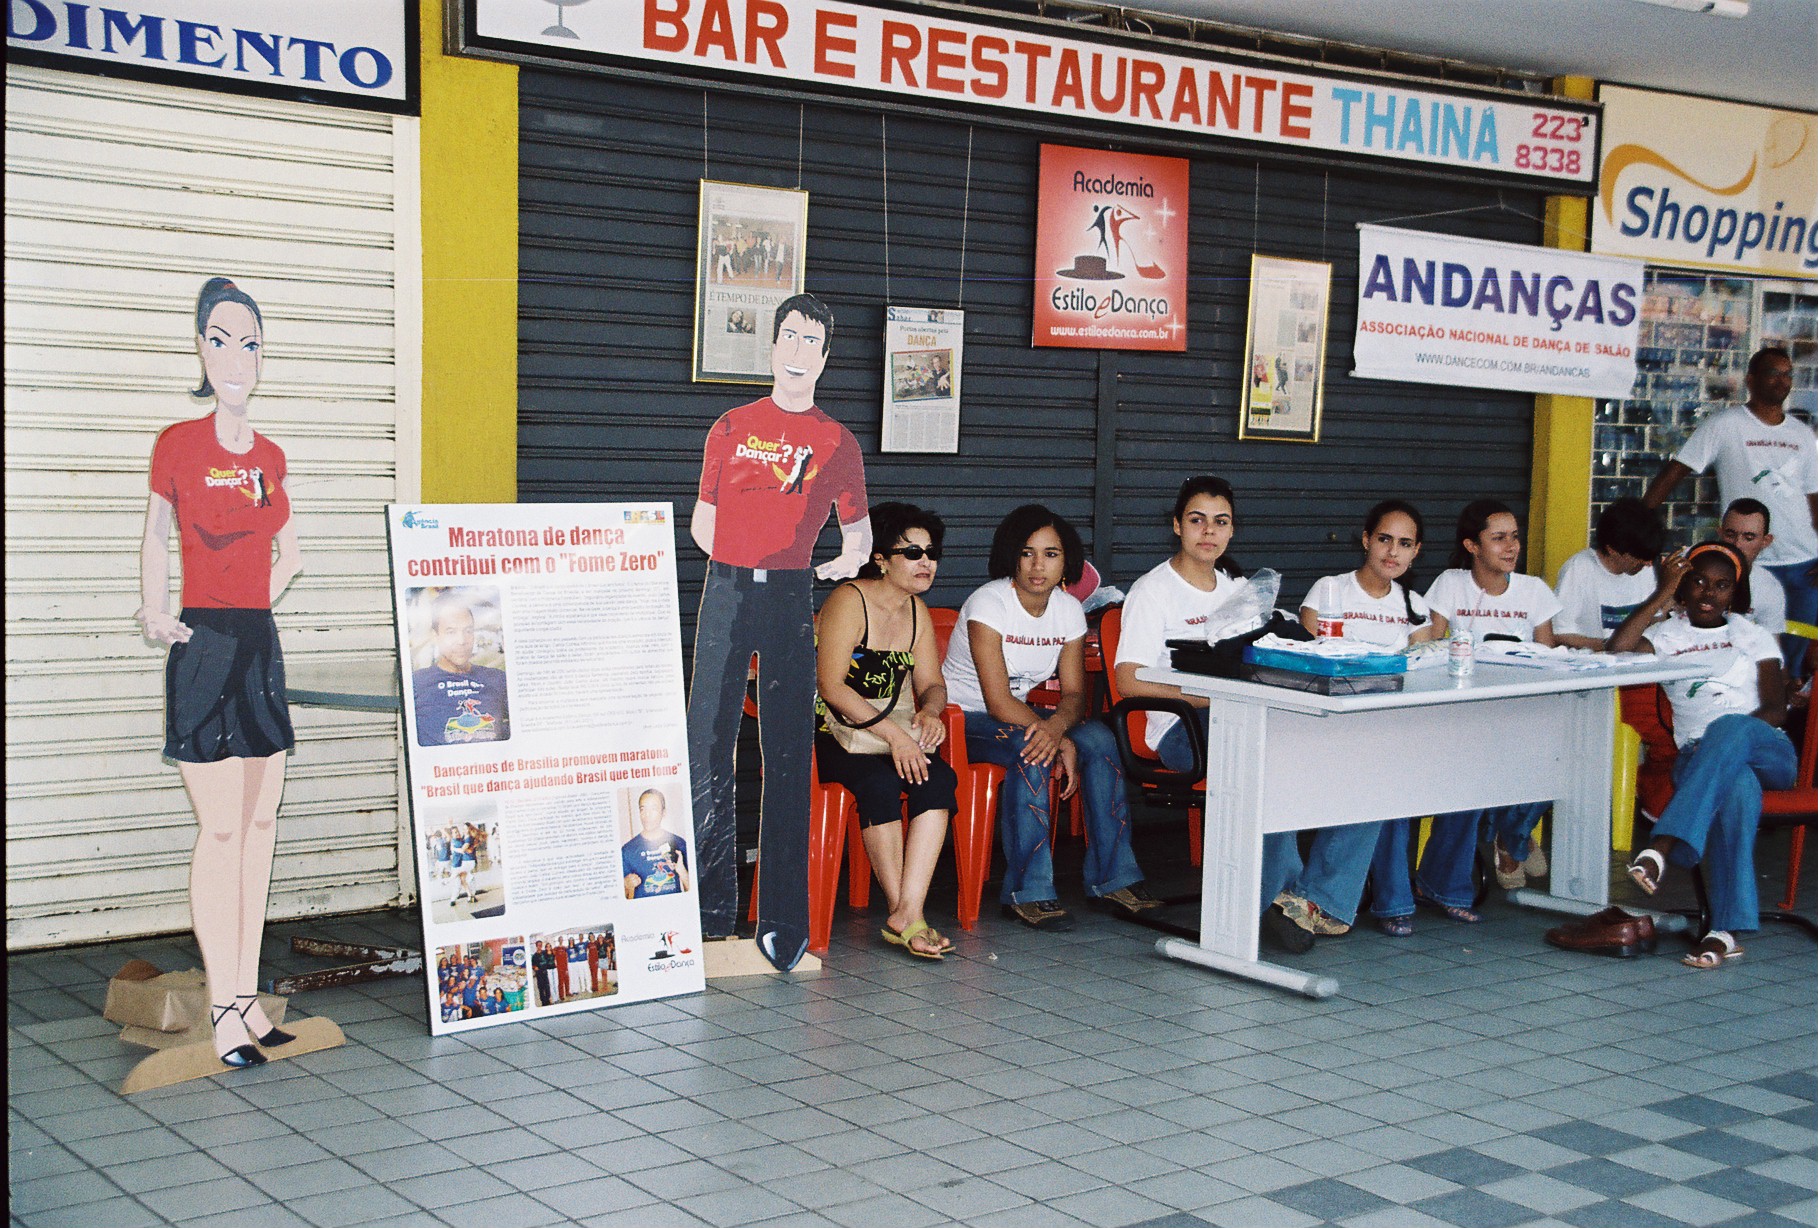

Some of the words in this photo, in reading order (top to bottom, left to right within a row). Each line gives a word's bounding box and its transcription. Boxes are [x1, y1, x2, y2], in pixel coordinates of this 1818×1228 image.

[643, 0, 789, 69] BAR
[814, 10, 857, 79] E
[881, 20, 1313, 140] RESTAURANTE
[1332, 87, 1499, 164] THAINÁ
[1532, 113, 1582, 142] 223
[1515, 144, 1581, 174] 8338
[1073, 170, 1154, 198] Academia
[1052, 286, 1096, 312] Estilo
[1111, 289, 1168, 320] Dança
[1362, 254, 1637, 332] ANDANÇAS
[1050, 325, 1169, 340] www.estiloedanca.com.br
[1360, 320, 1445, 340] ASSOCIAÇÃO
[1450, 328, 1508, 347] NACIONAL
[1513, 335, 1528, 348] DE
[1533, 337, 1571, 353] DANÇA
[1575, 342, 1589, 354] DE
[1595, 344, 1630, 358] SALÃO
[736, 444, 793, 465] Dançar?
[747, 435, 780, 452] Quer
[210, 468, 236, 478] Quer
[448, 527, 539, 548] Maratona
[543, 526, 566, 546] de
[570, 525, 624, 549] dança
[407, 554, 496, 577] contribui
[501, 558, 541, 575] com
[546, 556, 555, 573] o
[560, 553, 615, 573] "Fome
[620, 550, 664, 572] Zero"
[1343, 611, 1378, 621] BRASÍLIA
[1385, 615, 1395, 623] DA
[1501, 610, 1511, 619] DA
[1005, 633, 1035, 646] BRASÍLIA
[1042, 637, 1051, 646] DA
[1052, 637, 1066, 646] PAZ
[434, 763, 499, 780] Dançarinos
[501, 760, 514, 772] de
[562, 753, 618, 770] promovem
[620, 747, 668, 762] maratona
[421, 781, 461, 798] "Brasil
[463, 781, 484, 797] que
[486, 778, 521, 795] dança
[523, 773, 574, 790] ajudando
[576, 769, 607, 785] Brasil
[609, 770, 629, 784] que
[631, 767, 650, 779] tem
[652, 763, 682, 778] fome"
